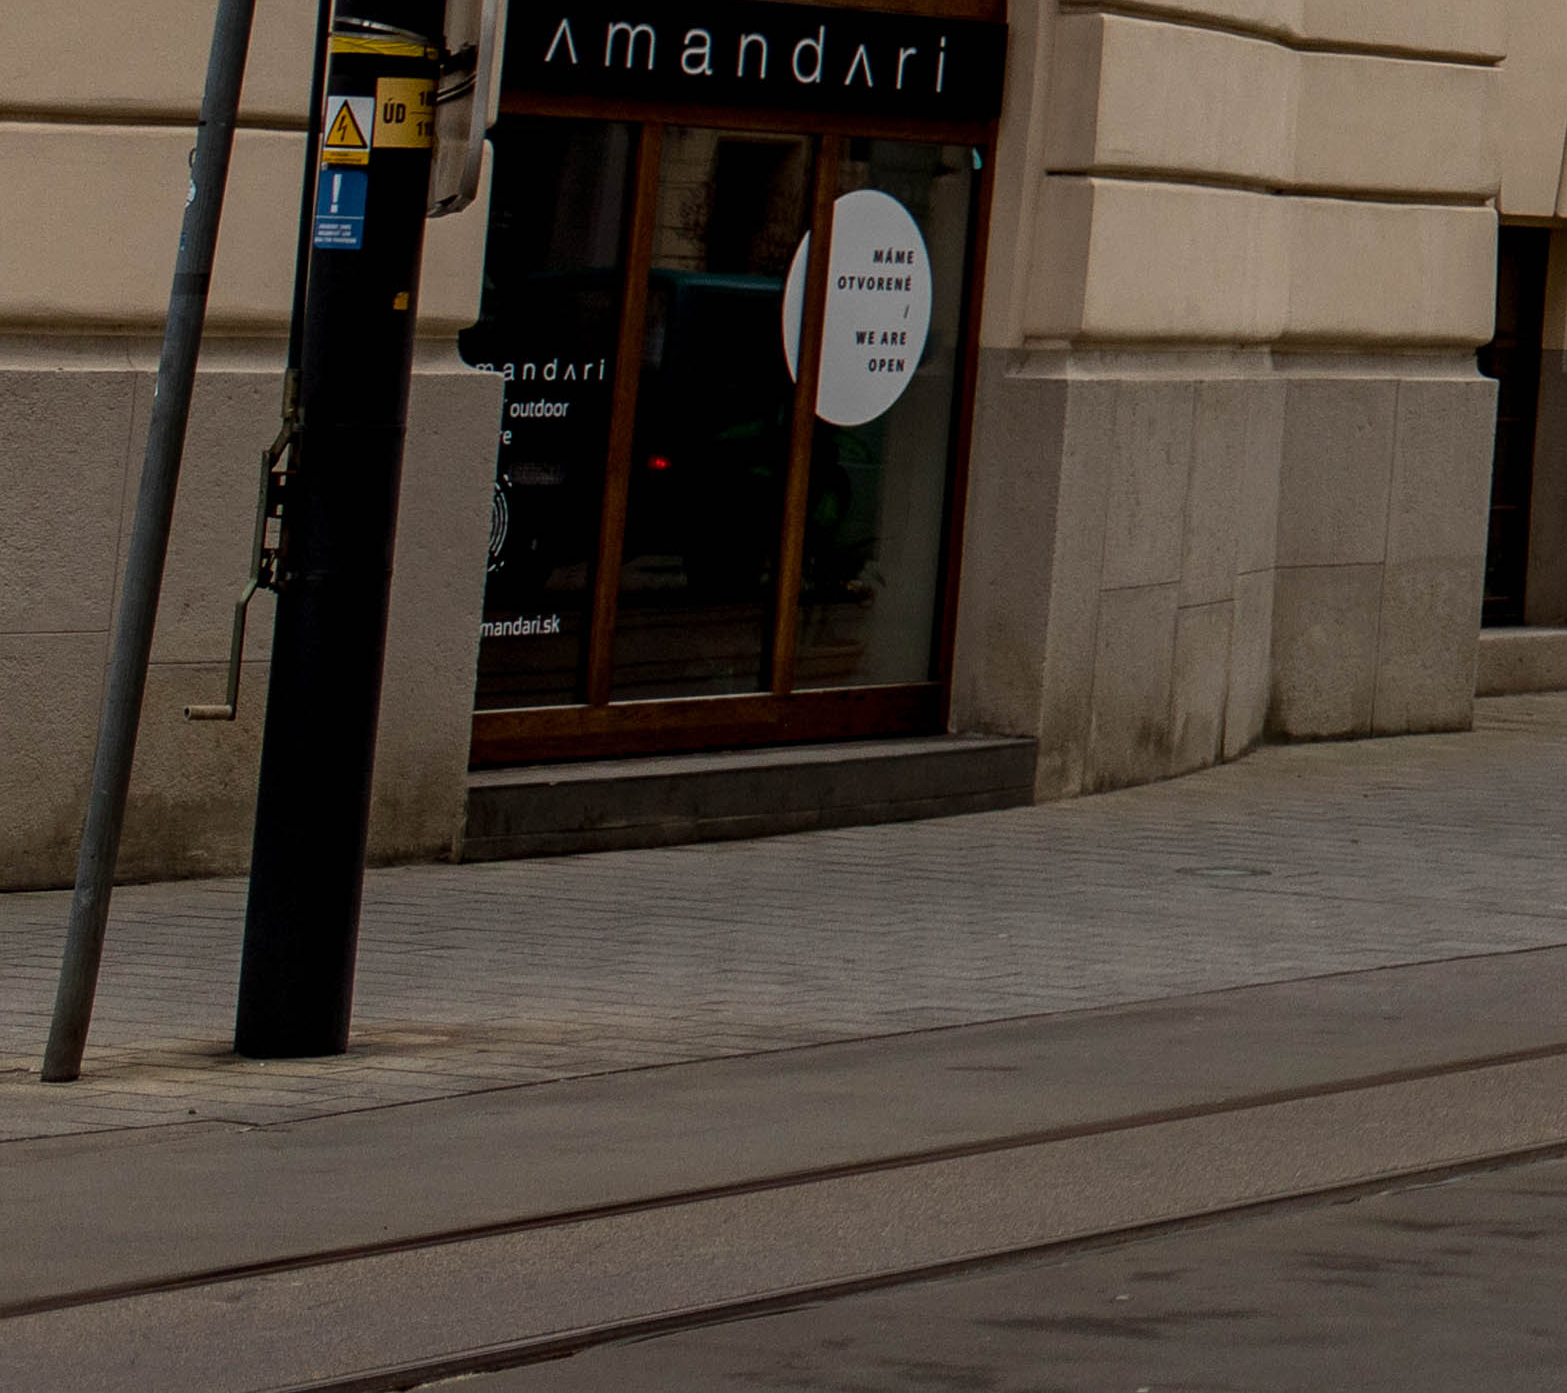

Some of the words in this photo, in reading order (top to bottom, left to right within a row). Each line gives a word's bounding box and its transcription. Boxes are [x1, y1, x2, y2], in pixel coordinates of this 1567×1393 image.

[382, 97, 406, 124] ÚD
[872, 247, 915, 264] MÁME
[837, 275, 912, 292] OTVORENÉ
[856, 331, 875, 345] WE
[880, 332, 907, 346] ARE
[868, 358, 905, 372] OPEN
[509, 397, 570, 418] outdoor
